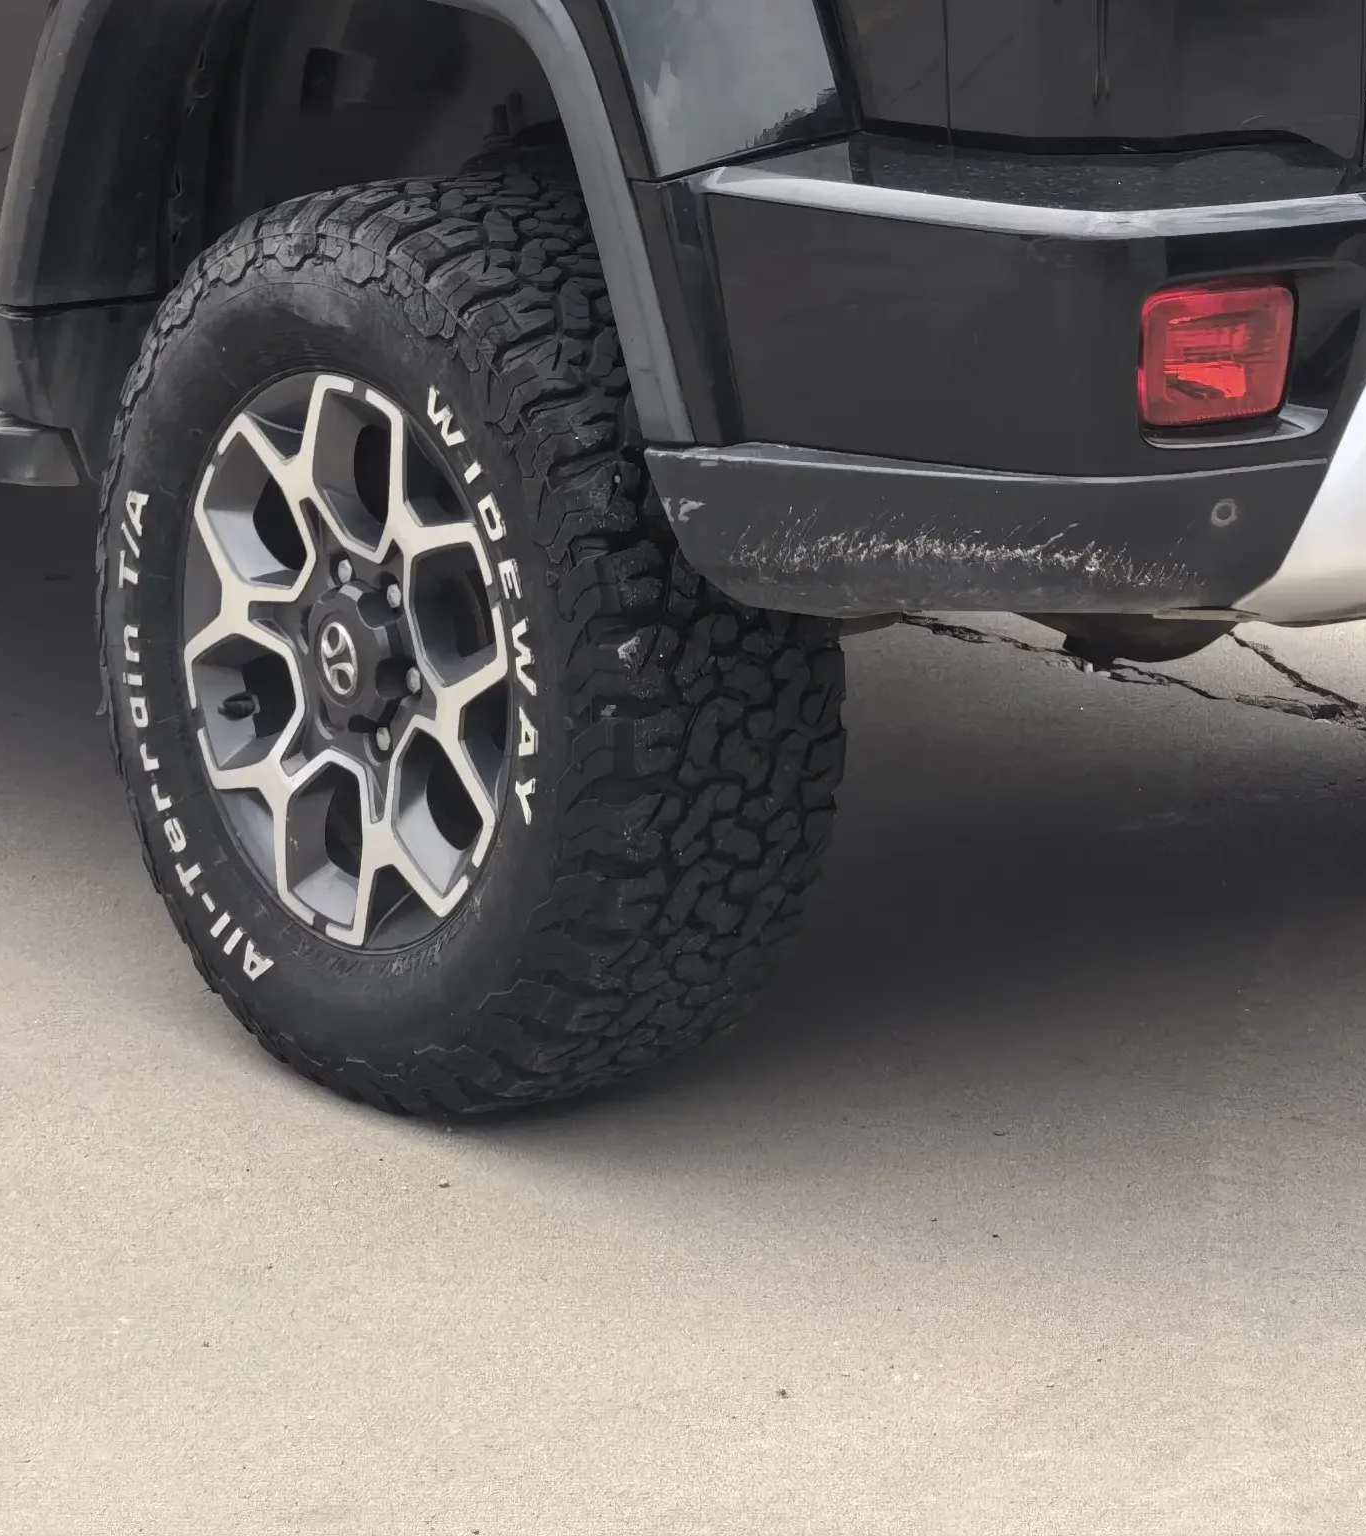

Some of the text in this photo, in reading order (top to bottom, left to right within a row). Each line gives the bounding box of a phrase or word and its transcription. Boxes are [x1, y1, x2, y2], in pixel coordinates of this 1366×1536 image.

[119, 490, 275, 982] All-Terrain T/A
[427, 384, 539, 826] WIDEWAY
